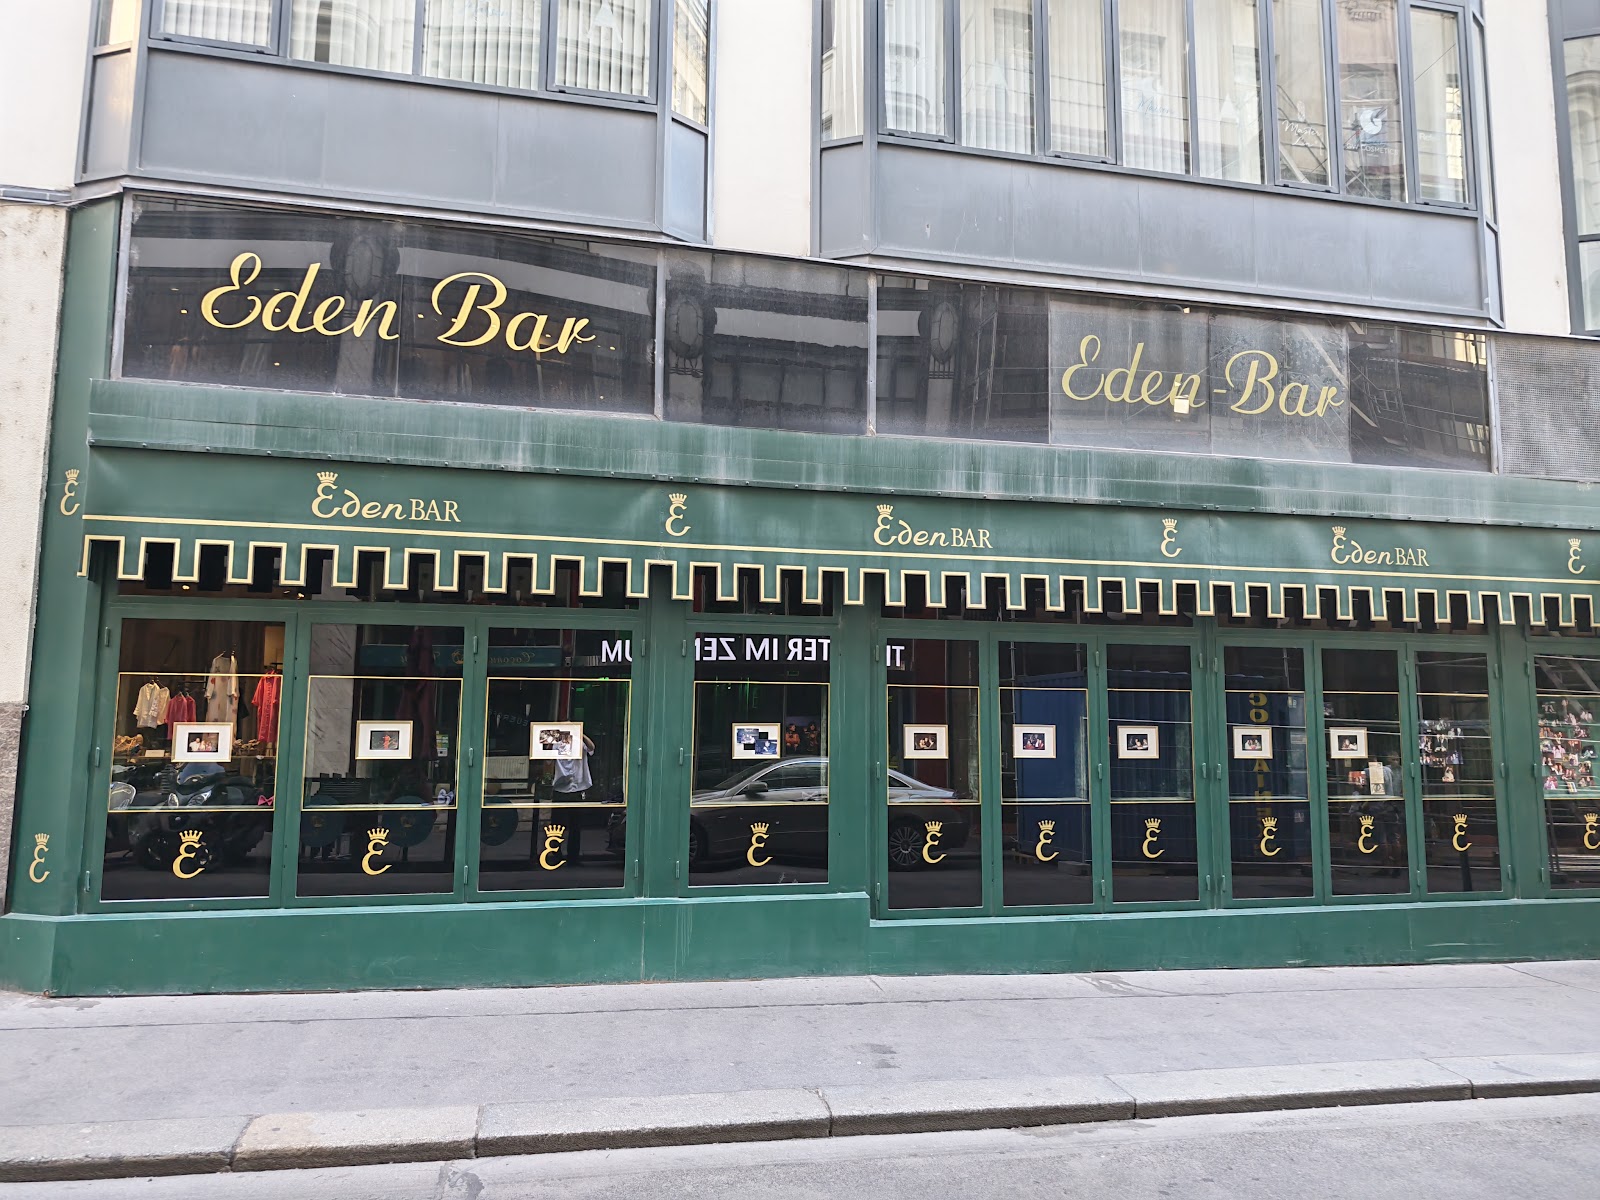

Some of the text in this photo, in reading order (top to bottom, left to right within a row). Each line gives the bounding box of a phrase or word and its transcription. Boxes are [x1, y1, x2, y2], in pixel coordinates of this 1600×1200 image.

[200, 252, 597, 354] Eden Bar
[311, 482, 462, 523] Eden BAR
[873, 513, 994, 549] Eden BAR
[1330, 535, 1430, 567] Eden BAR
